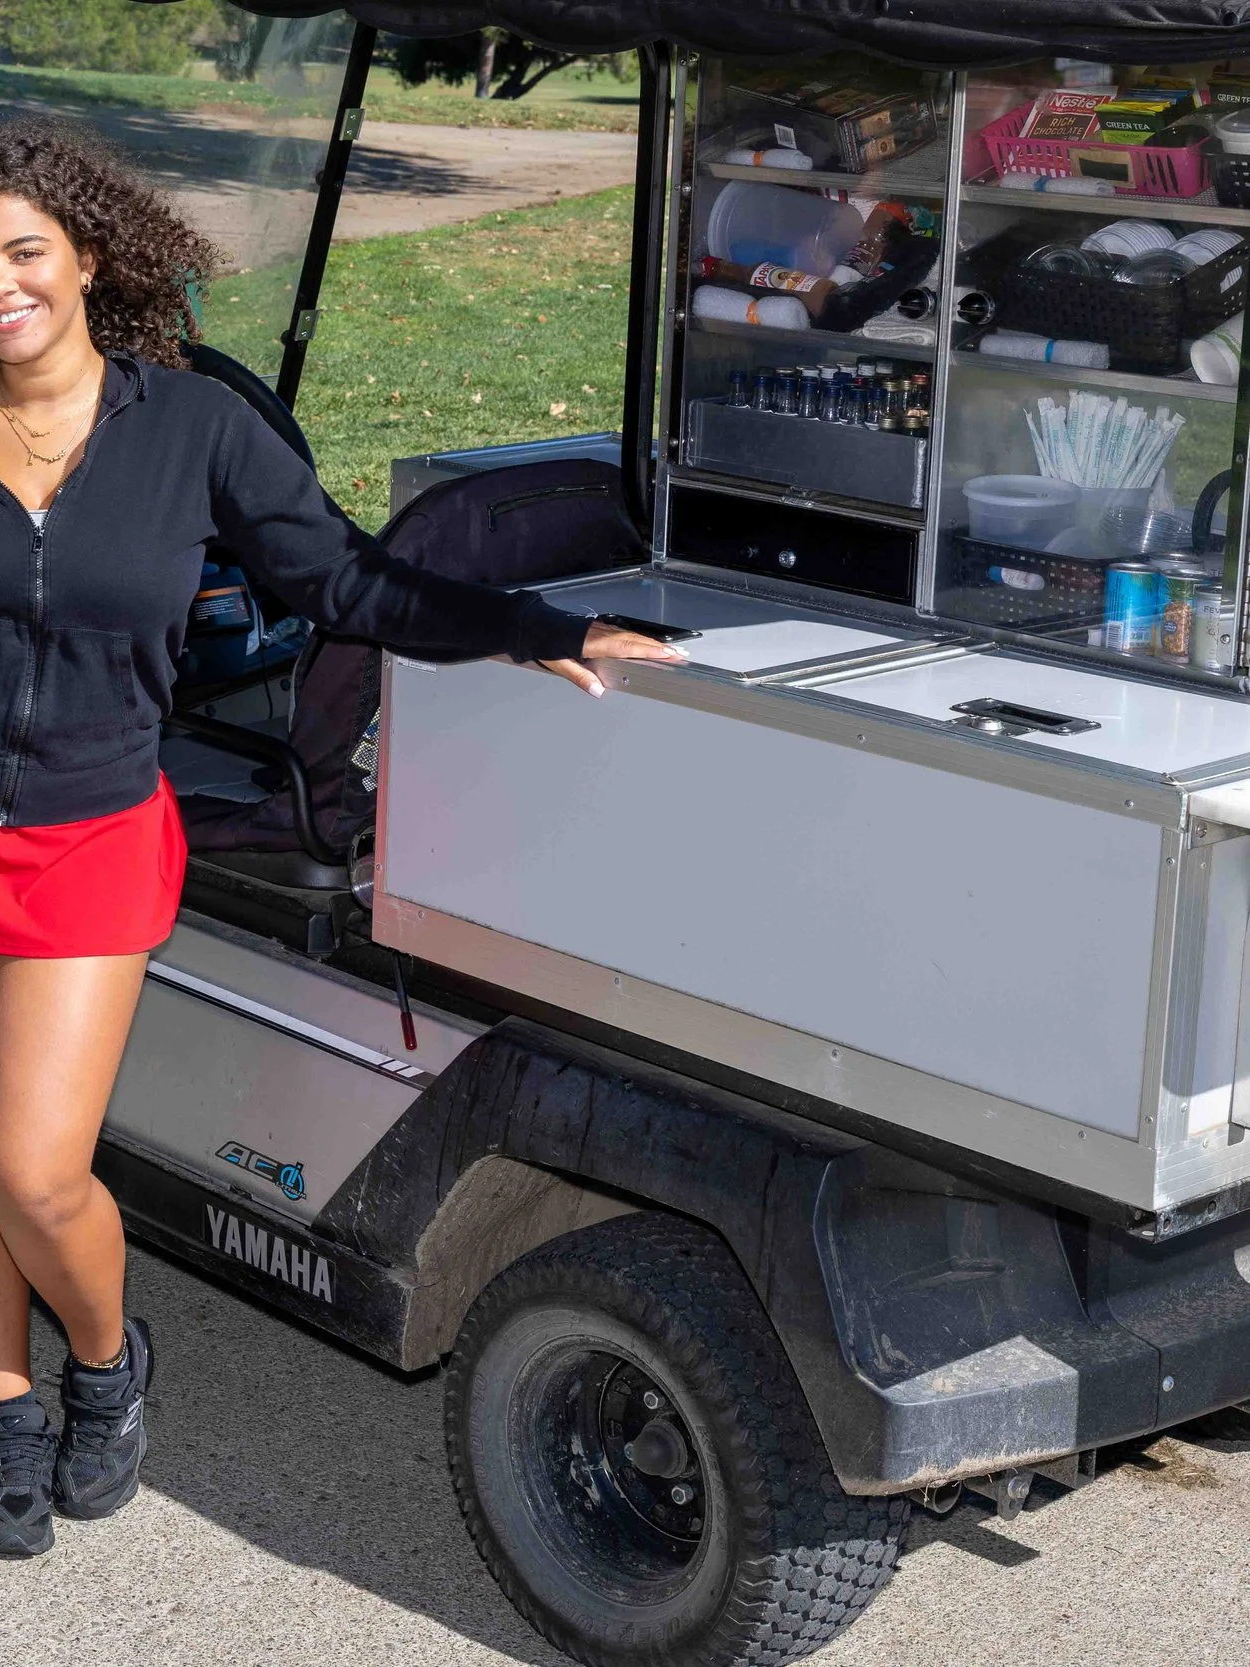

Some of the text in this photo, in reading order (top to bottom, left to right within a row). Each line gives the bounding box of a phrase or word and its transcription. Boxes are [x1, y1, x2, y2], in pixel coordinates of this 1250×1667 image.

[1049, 117, 1076, 127] RICH
[1105, 121, 1150, 131] GREEN TEA
[1033, 126, 1084, 136] CHOCOLATE
[206, 1204, 333, 1304] YAMAHA
